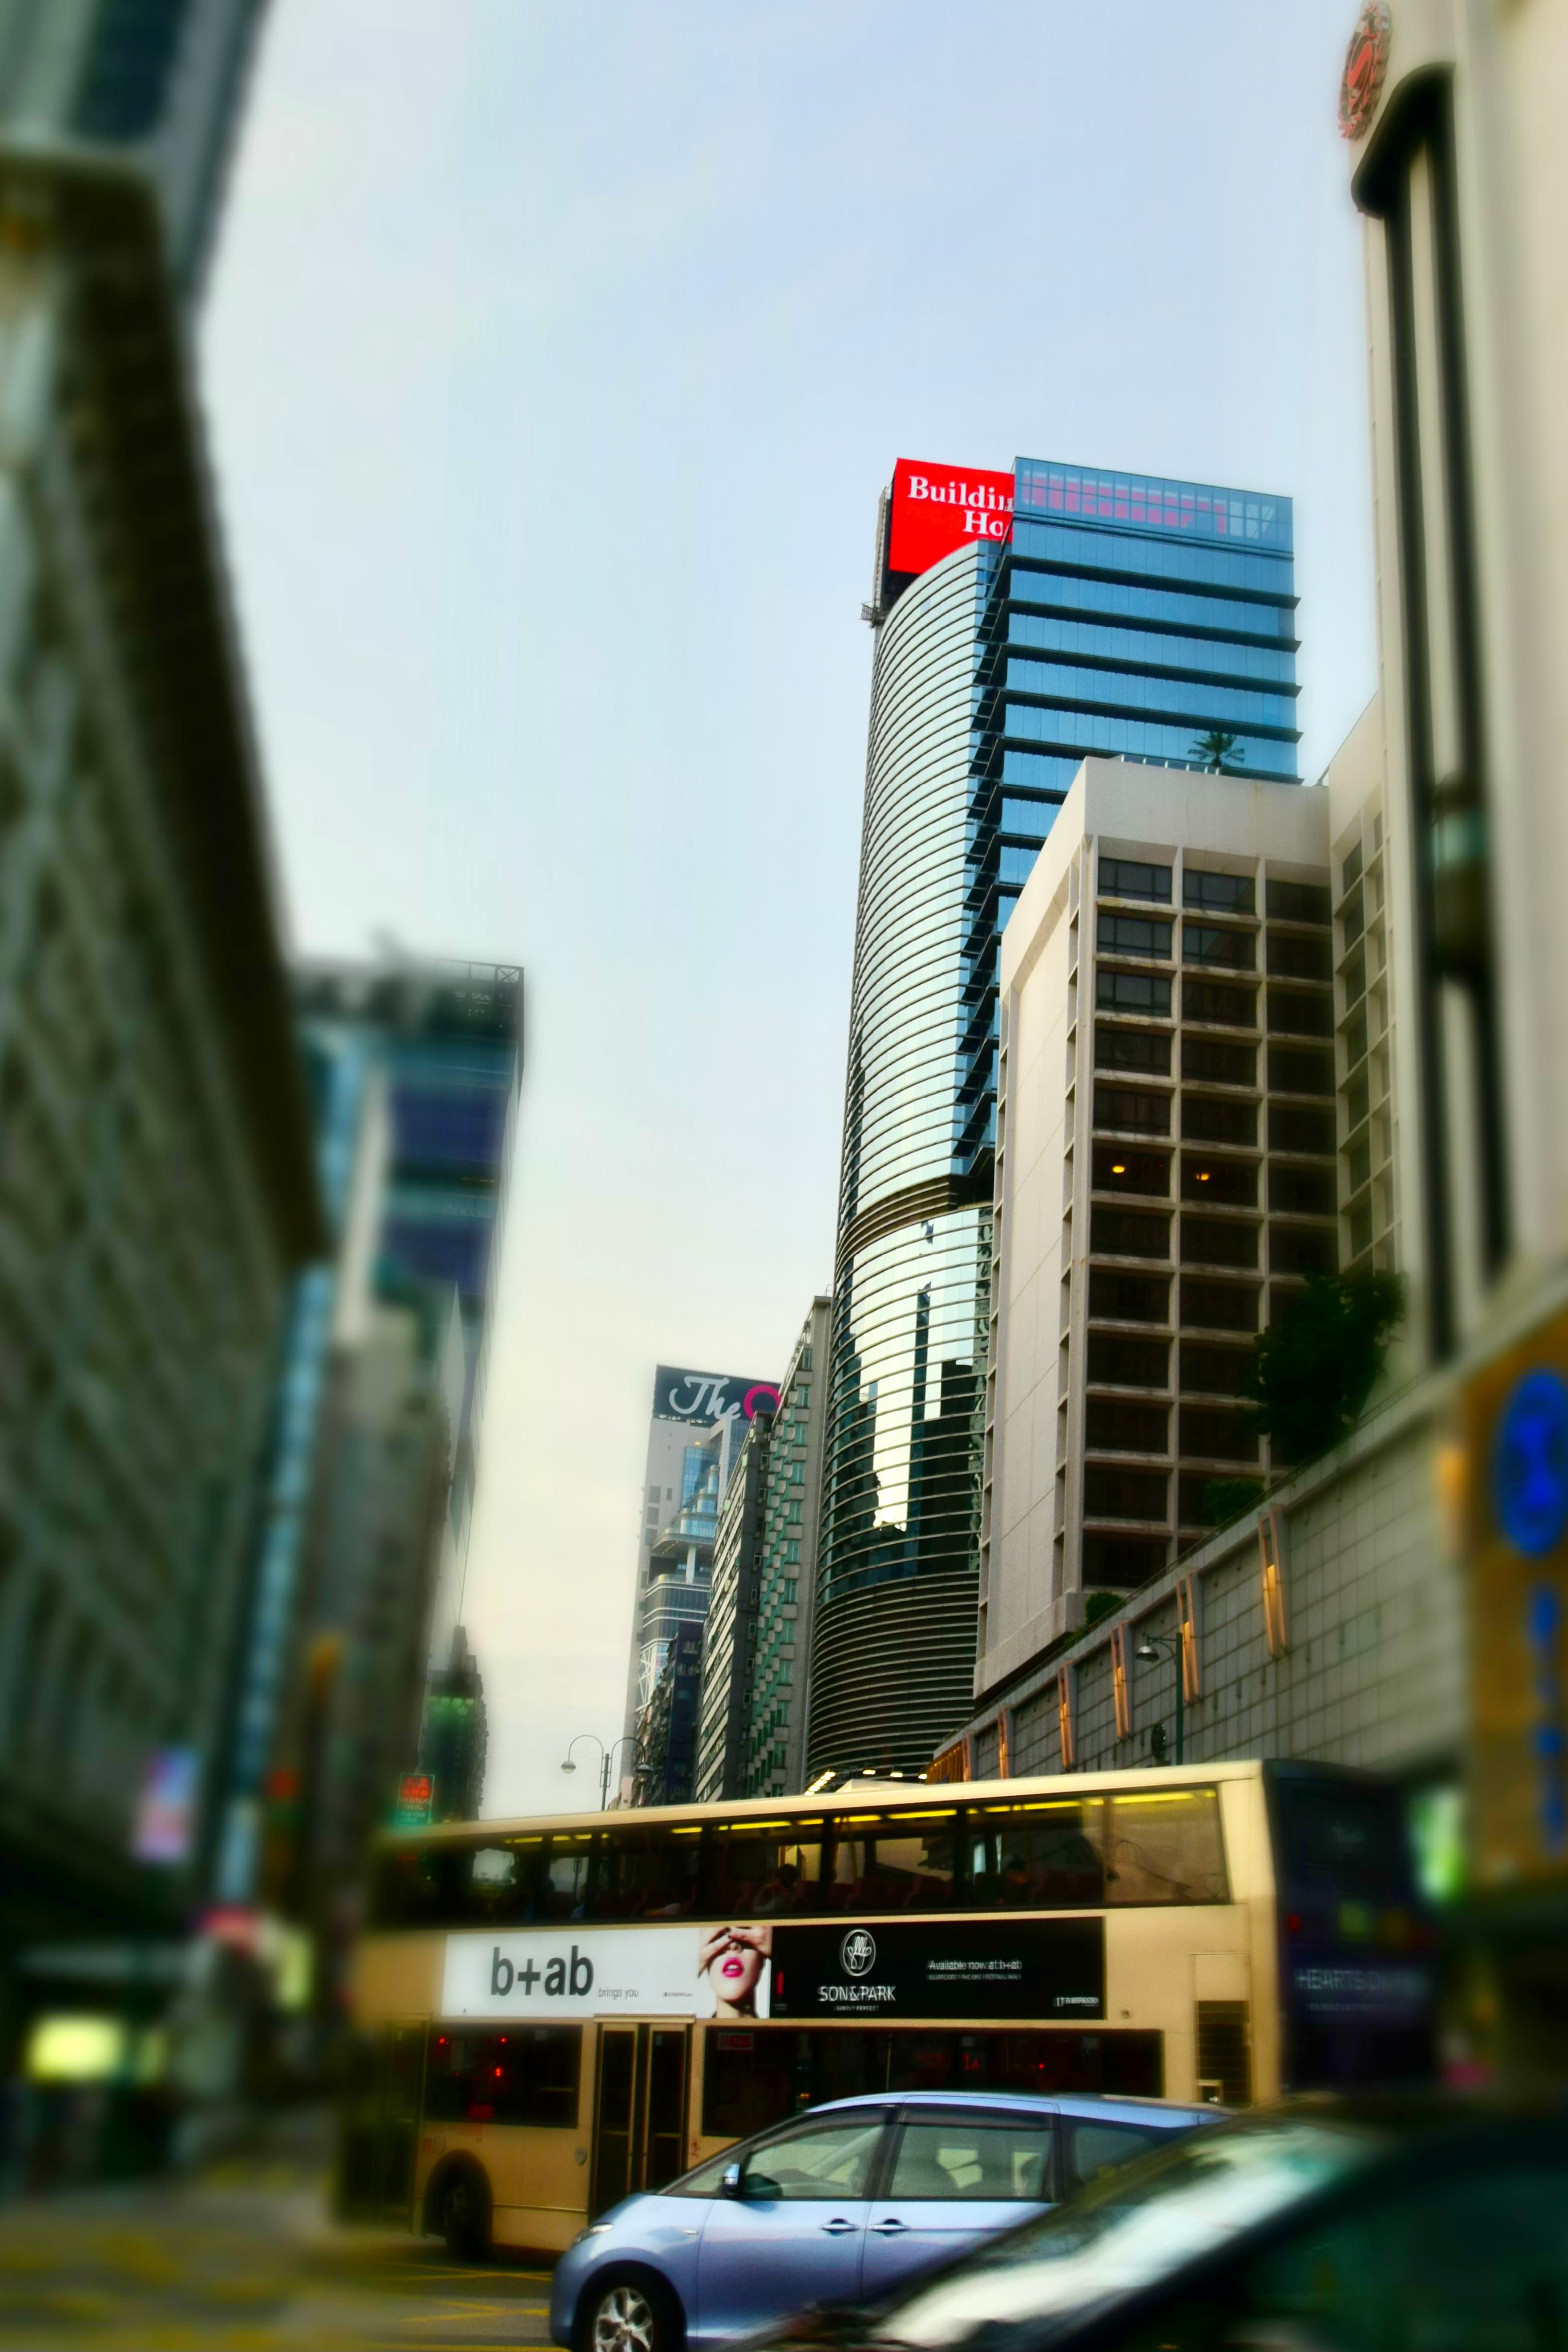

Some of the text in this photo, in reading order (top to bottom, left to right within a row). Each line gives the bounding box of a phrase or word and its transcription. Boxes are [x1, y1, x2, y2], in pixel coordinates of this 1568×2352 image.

[669, 1375, 741, 1420] The
[491, 1945, 594, 1997] b+ab
[929, 1960, 967, 1970] Available
[969, 1961, 987, 1970] now
[988, 1960, 997, 1970] at
[598, 1986, 640, 2000] brings you
[818, 1985, 896, 2002] SON&PARK
